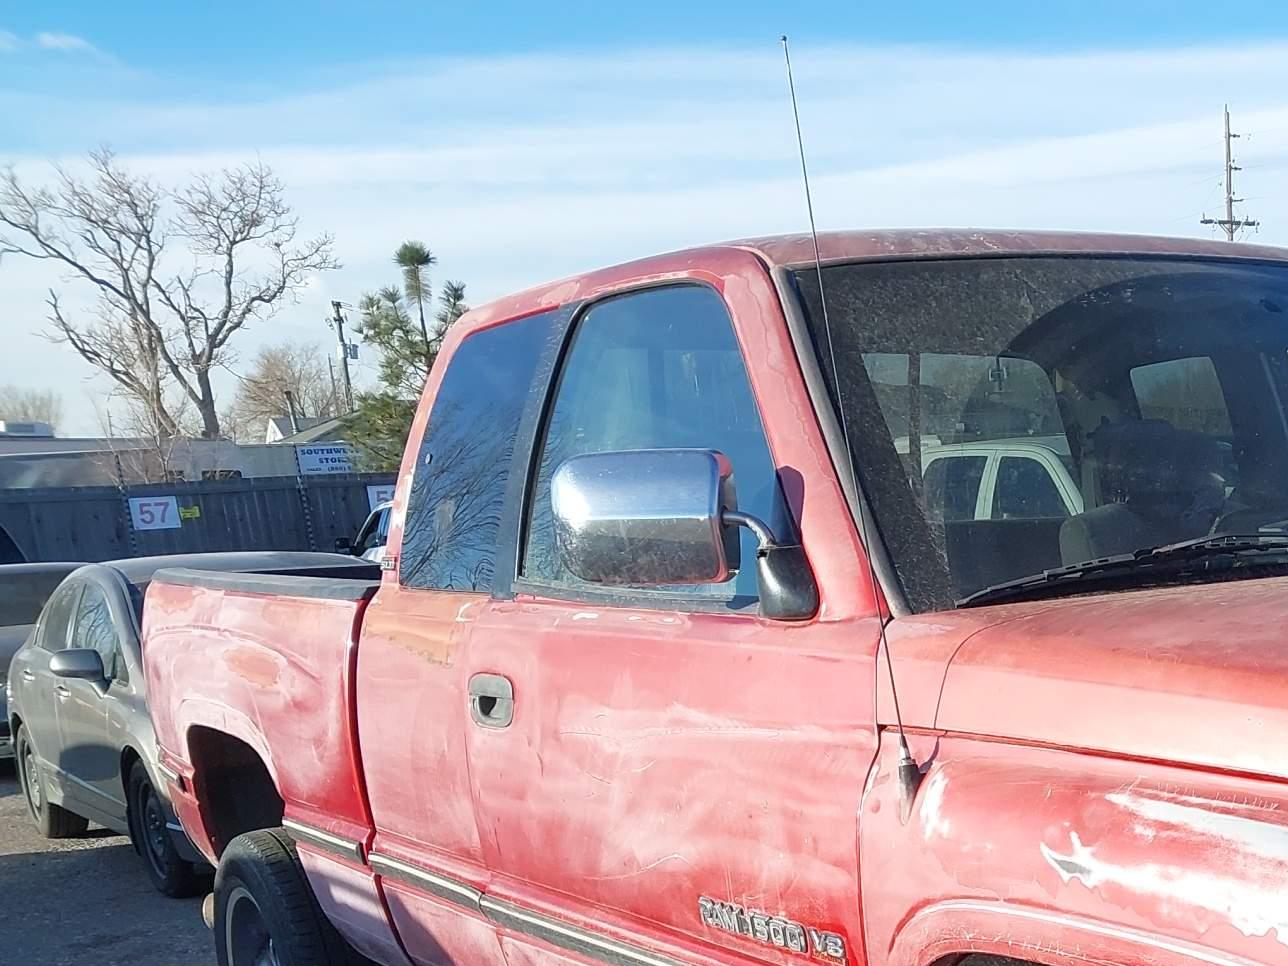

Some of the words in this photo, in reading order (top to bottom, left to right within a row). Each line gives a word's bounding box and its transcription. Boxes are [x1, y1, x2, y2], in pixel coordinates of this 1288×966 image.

[139, 502, 170, 525] 57
[699, 896, 742, 935] RAM
[743, 911, 808, 953] 1500
